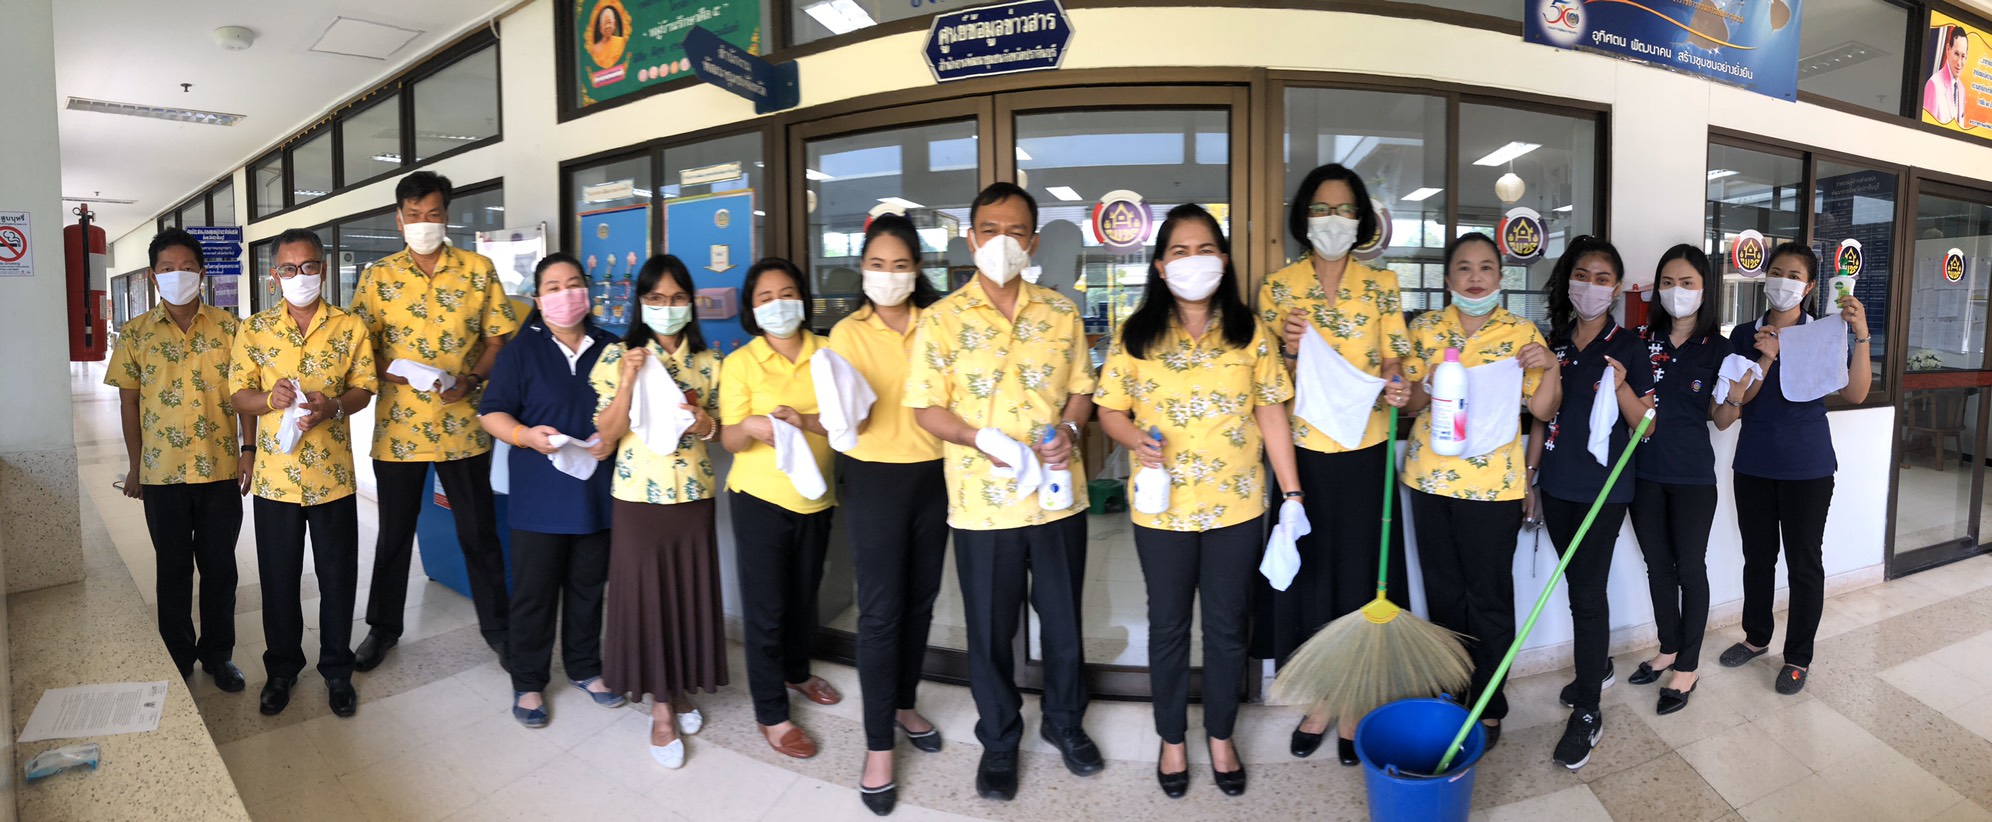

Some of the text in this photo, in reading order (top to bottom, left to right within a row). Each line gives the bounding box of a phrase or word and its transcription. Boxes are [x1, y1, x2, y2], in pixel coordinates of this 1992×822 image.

[938, 8, 1057, 54] ศูนย์ข้อมูลข่าวสาร
[1592, 30, 1627, 47] อุทิศตน
[1631, 38, 1672, 58] พัฒนาคน
[1678, 50, 1754, 80] สร้างชุมชนอย่างยั่งยืน
